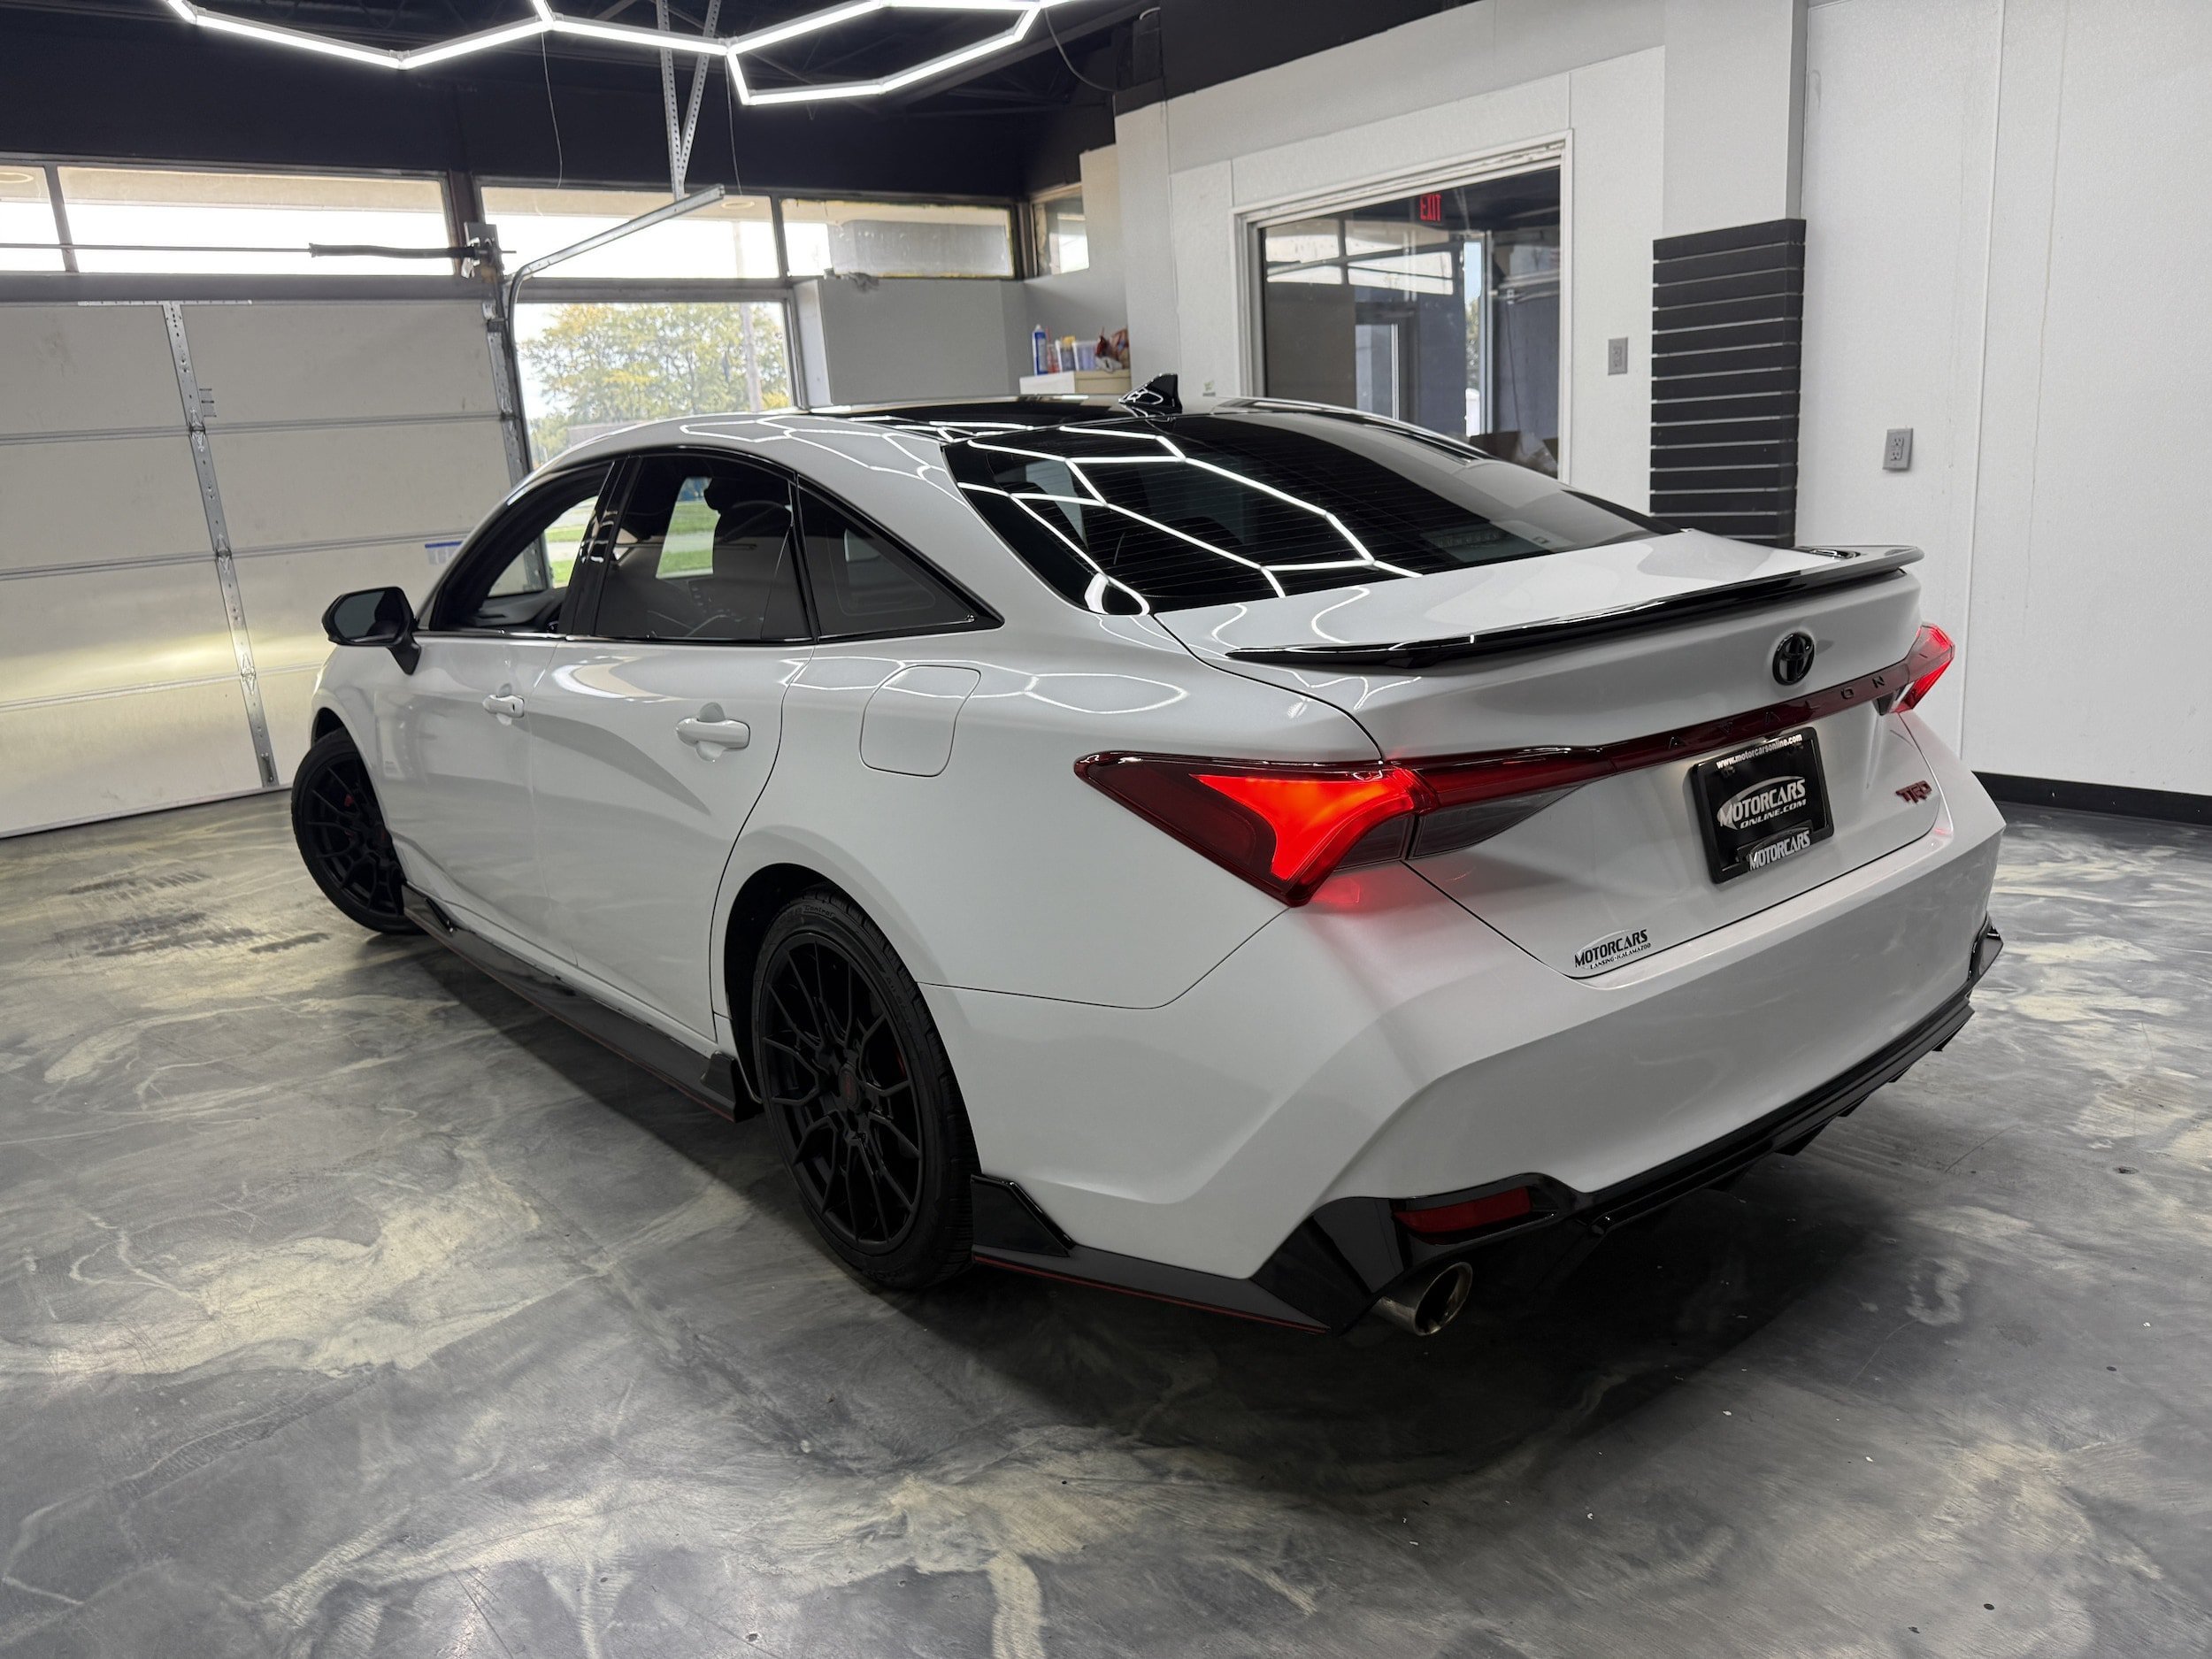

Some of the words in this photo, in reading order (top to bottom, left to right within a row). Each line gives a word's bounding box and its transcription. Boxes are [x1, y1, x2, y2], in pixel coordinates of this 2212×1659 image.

[1420, 194, 1441, 221] EXIT
[1717, 733, 1803, 769] www.motorcarsonline.com
[1718, 779, 1806, 826] MOTORCARS
[1895, 780, 1932, 803] TRD
[1740, 799, 1807, 829] ONLINE.COM
[1748, 830, 1811, 871] MOTORCARS
[1574, 928, 1648, 968] MOTORCARS
